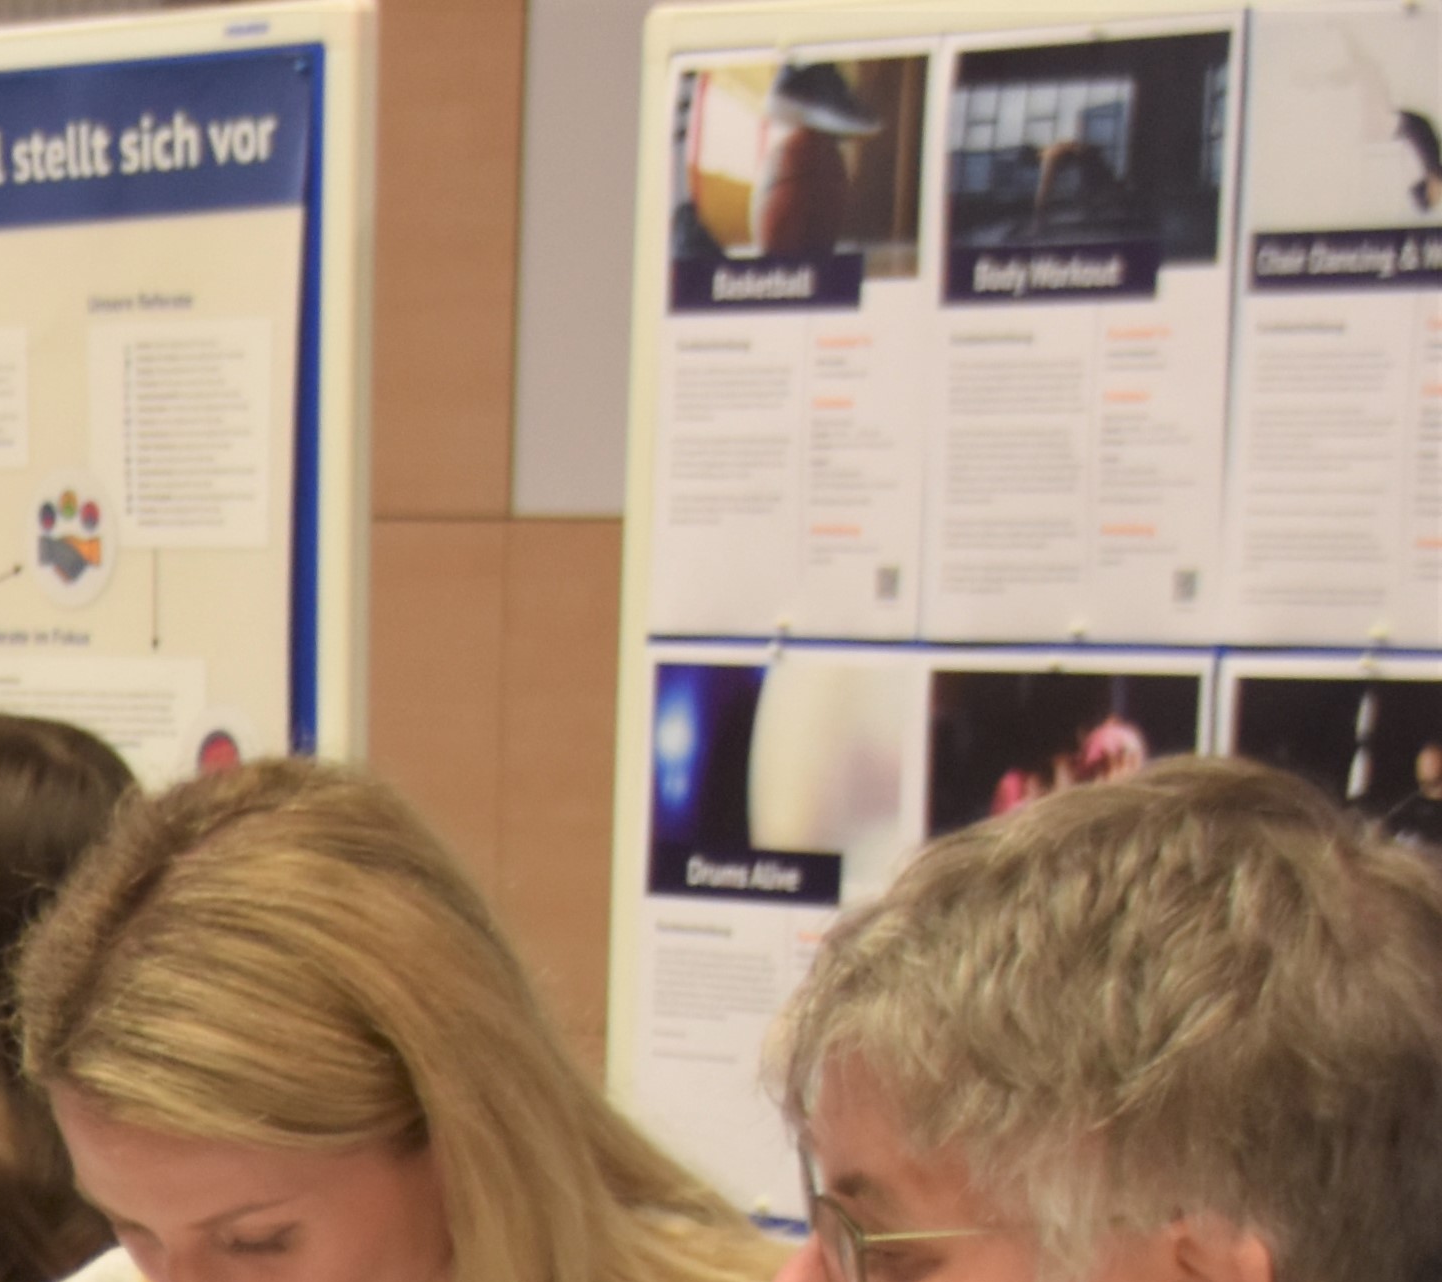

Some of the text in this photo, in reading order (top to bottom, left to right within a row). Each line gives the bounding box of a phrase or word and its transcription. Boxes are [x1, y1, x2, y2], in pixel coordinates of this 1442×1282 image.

[12, 119, 113, 186] stellt
[119, 111, 201, 175] sich
[208, 115, 278, 167] vor
